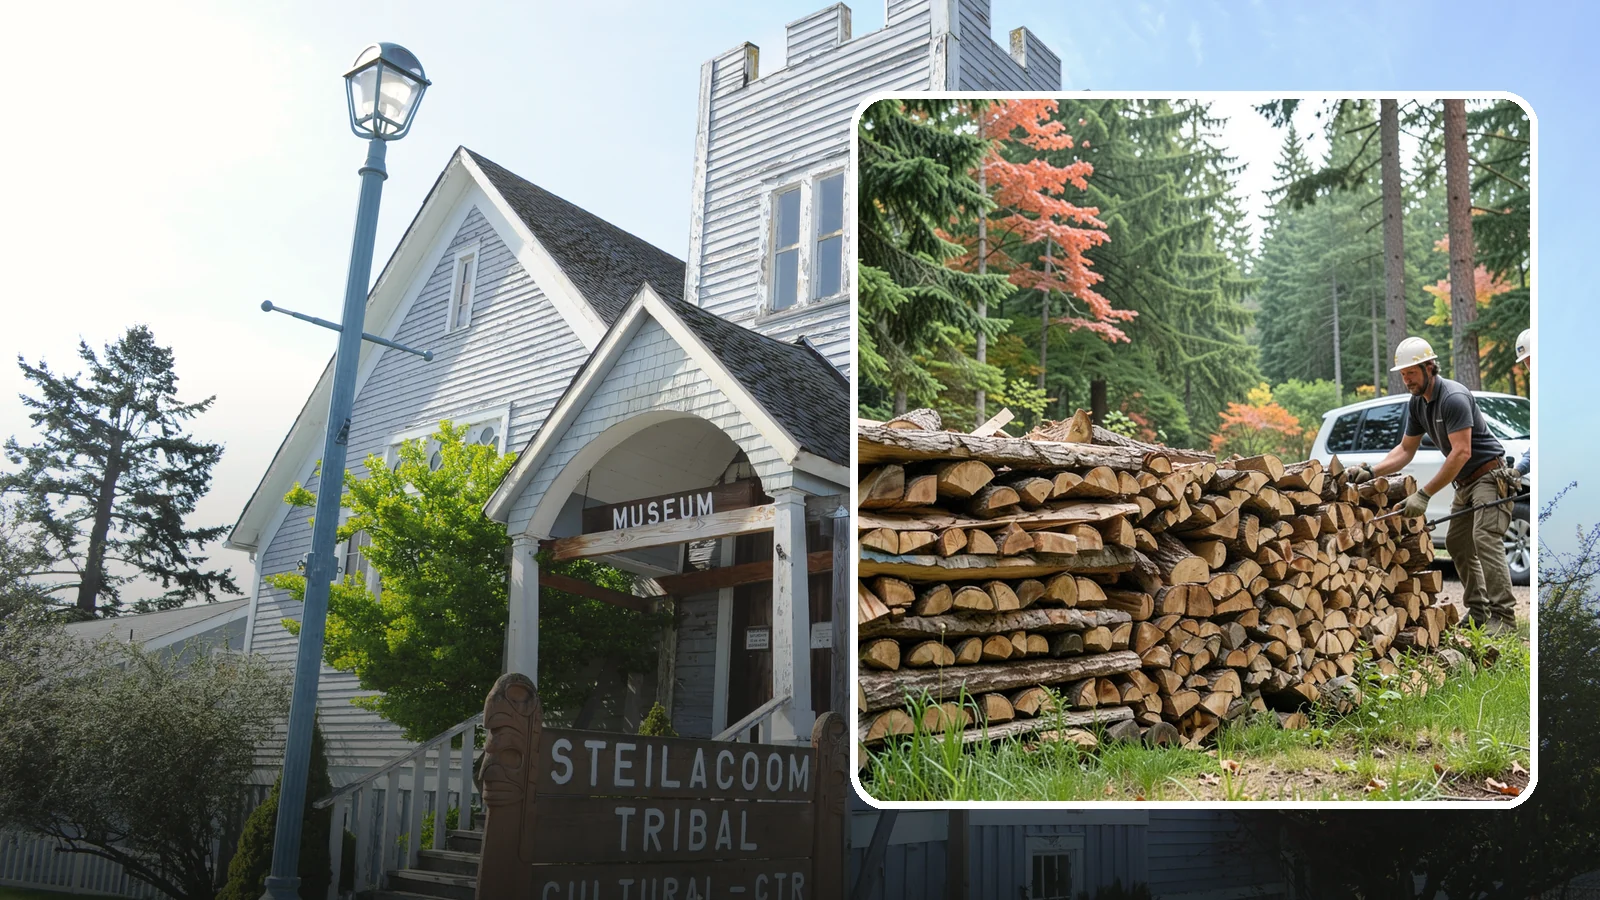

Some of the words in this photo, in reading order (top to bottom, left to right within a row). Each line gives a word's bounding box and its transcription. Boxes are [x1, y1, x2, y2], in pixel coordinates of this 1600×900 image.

[613, 491, 713, 531] MUSEUM
[550, 738, 809, 792] STEILACOOM
[614, 806, 757, 851] TRIBAL
